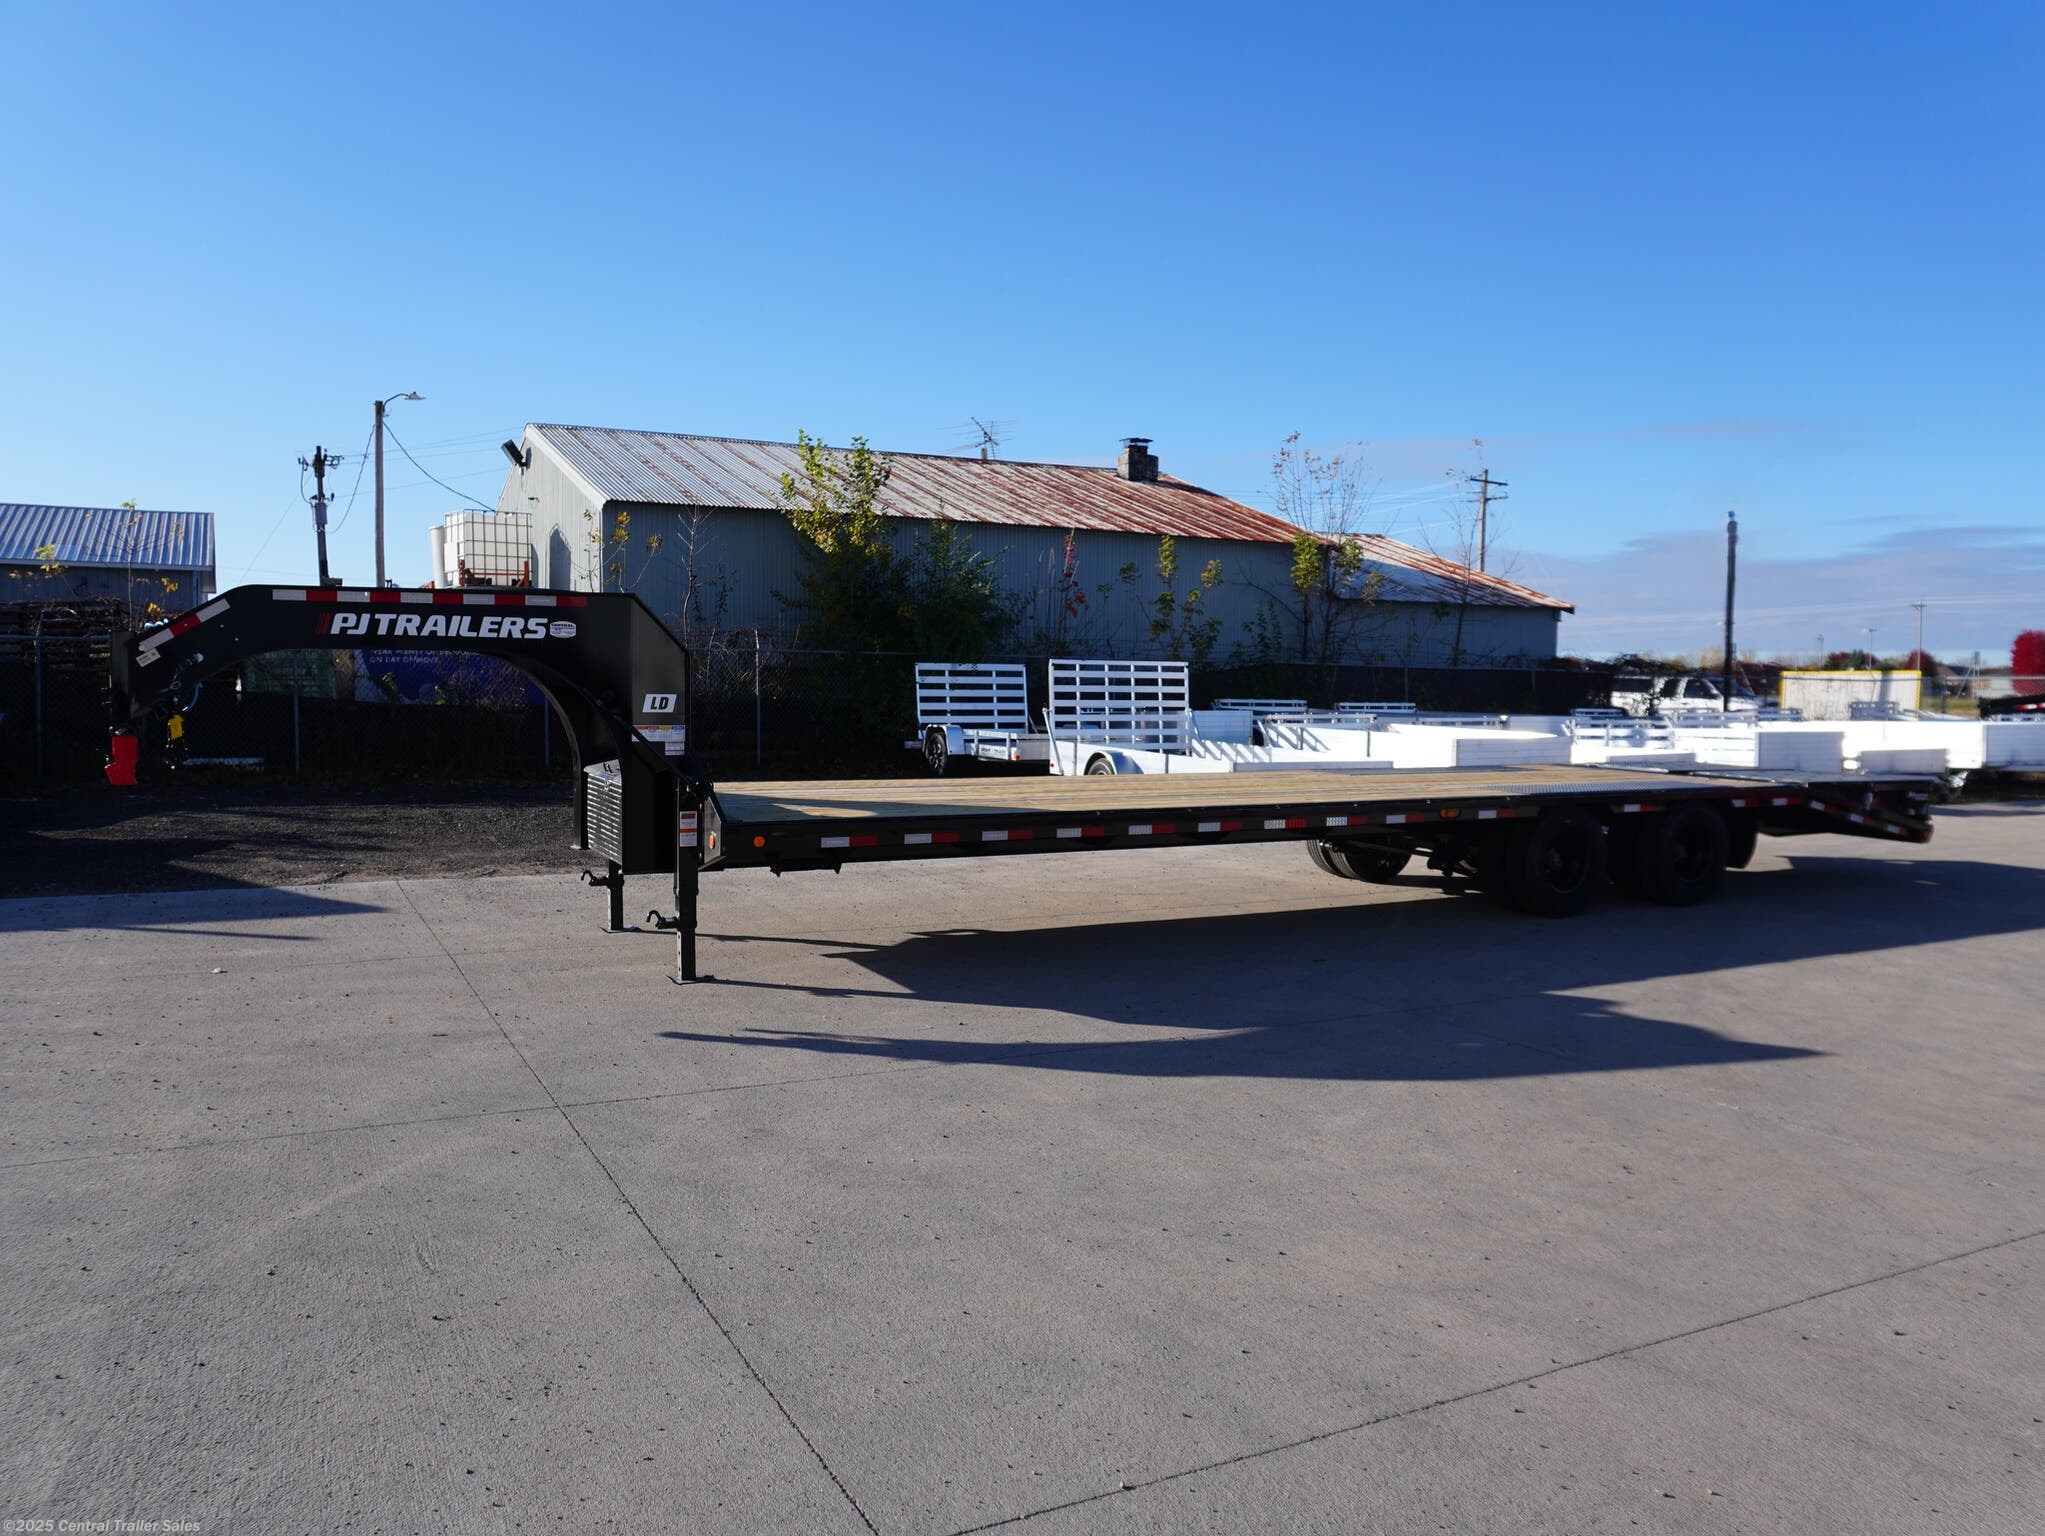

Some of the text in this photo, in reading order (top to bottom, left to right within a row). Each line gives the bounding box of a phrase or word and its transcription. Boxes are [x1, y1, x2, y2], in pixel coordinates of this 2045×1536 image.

[330, 612, 548, 639] PJ TRAILERS
[650, 696, 669, 710] LD
